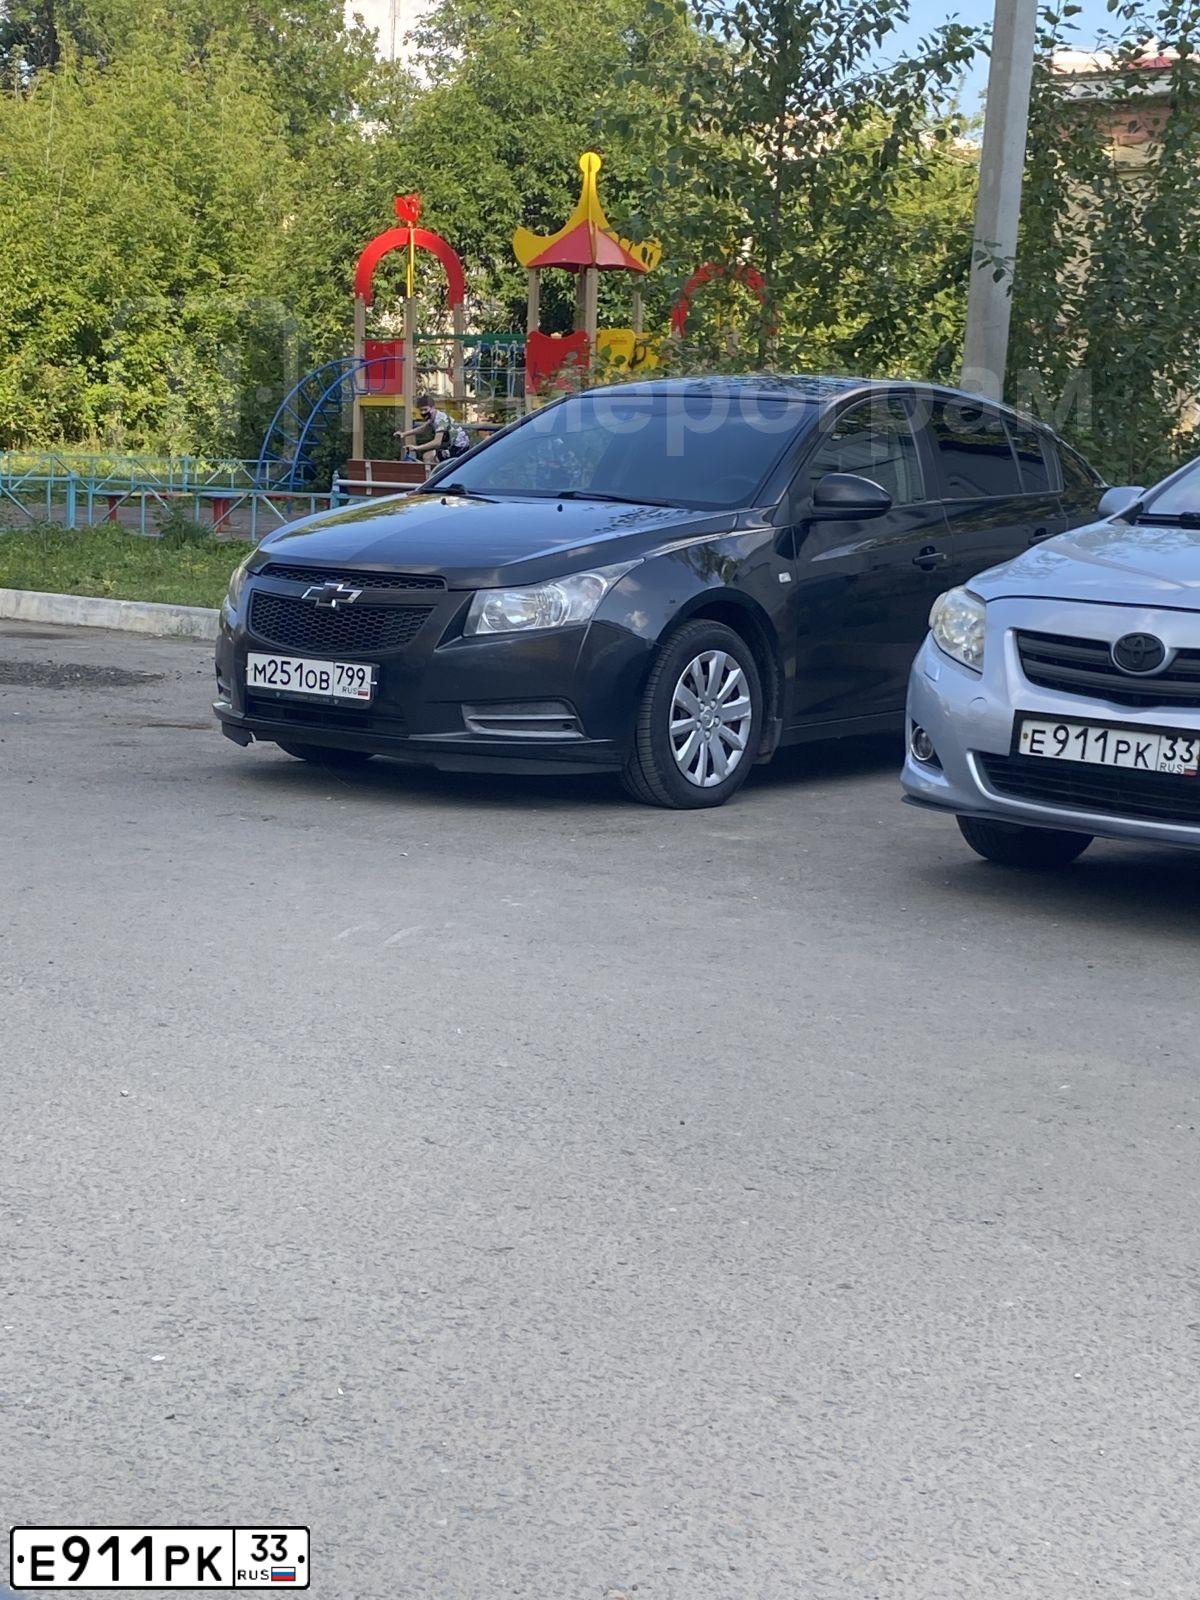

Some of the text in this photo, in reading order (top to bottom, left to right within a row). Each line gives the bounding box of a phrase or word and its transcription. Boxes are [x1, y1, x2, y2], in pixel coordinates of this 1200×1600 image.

[335, 665, 366, 687] 799
[342, 685, 358, 695] RUS
[1162, 735, 1195, 763] 33
[1159, 762, 1183, 774] RUS
